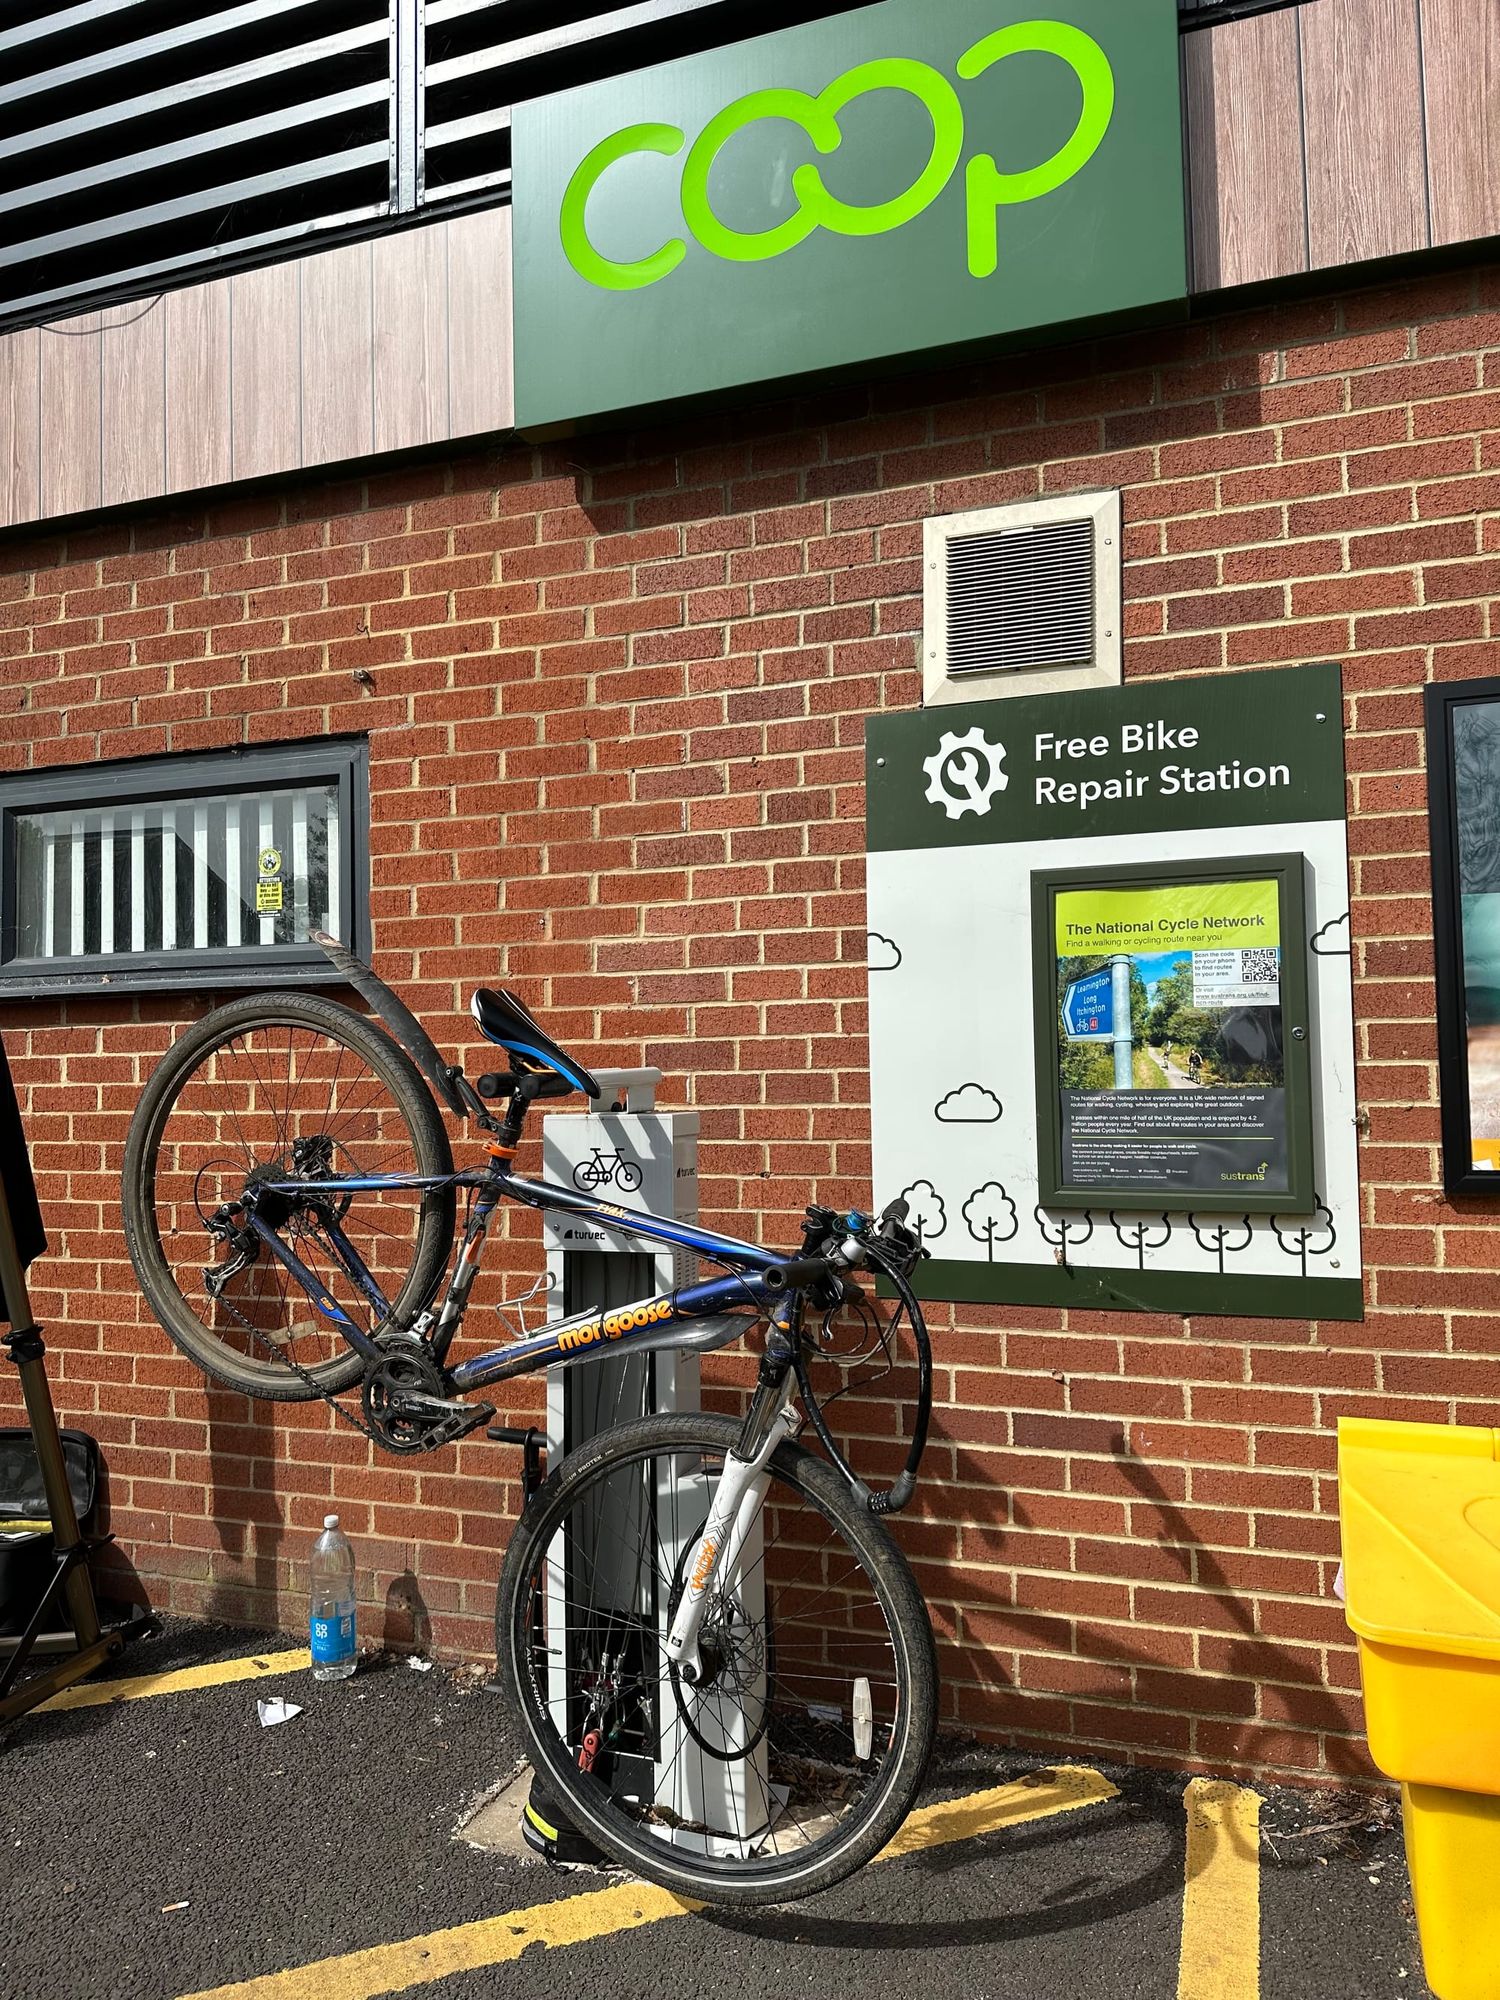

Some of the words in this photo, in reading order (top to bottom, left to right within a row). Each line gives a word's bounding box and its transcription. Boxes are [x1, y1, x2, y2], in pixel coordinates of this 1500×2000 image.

[1035, 732, 1110, 761] Free
[1122, 720, 1199, 753] Bike
[1035, 769, 1150, 810] Repair
[1159, 760, 1290, 795] Station
[1066, 924, 1092, 935] The
[1096, 920, 1154, 934] National
[1158, 918, 1199, 933] Cycle
[1203, 914, 1265, 929] Network
[1066, 939, 1083, 948] Find
[1092, 938, 1122, 948] walking
[1133, 936, 1161, 946] cycling
[1163, 935, 1184, 944] route
[1207, 934, 1222, 943] you
[1077, 977, 1110, 993] Leamington
[1084, 995, 1097, 1005] Long
[1077, 1004, 1105, 1016] Itchington
[681, 1167, 695, 1177] turvec
[1221, 1171, 1265, 1181] sustrans
[574, 1230, 606, 1241] turvec
